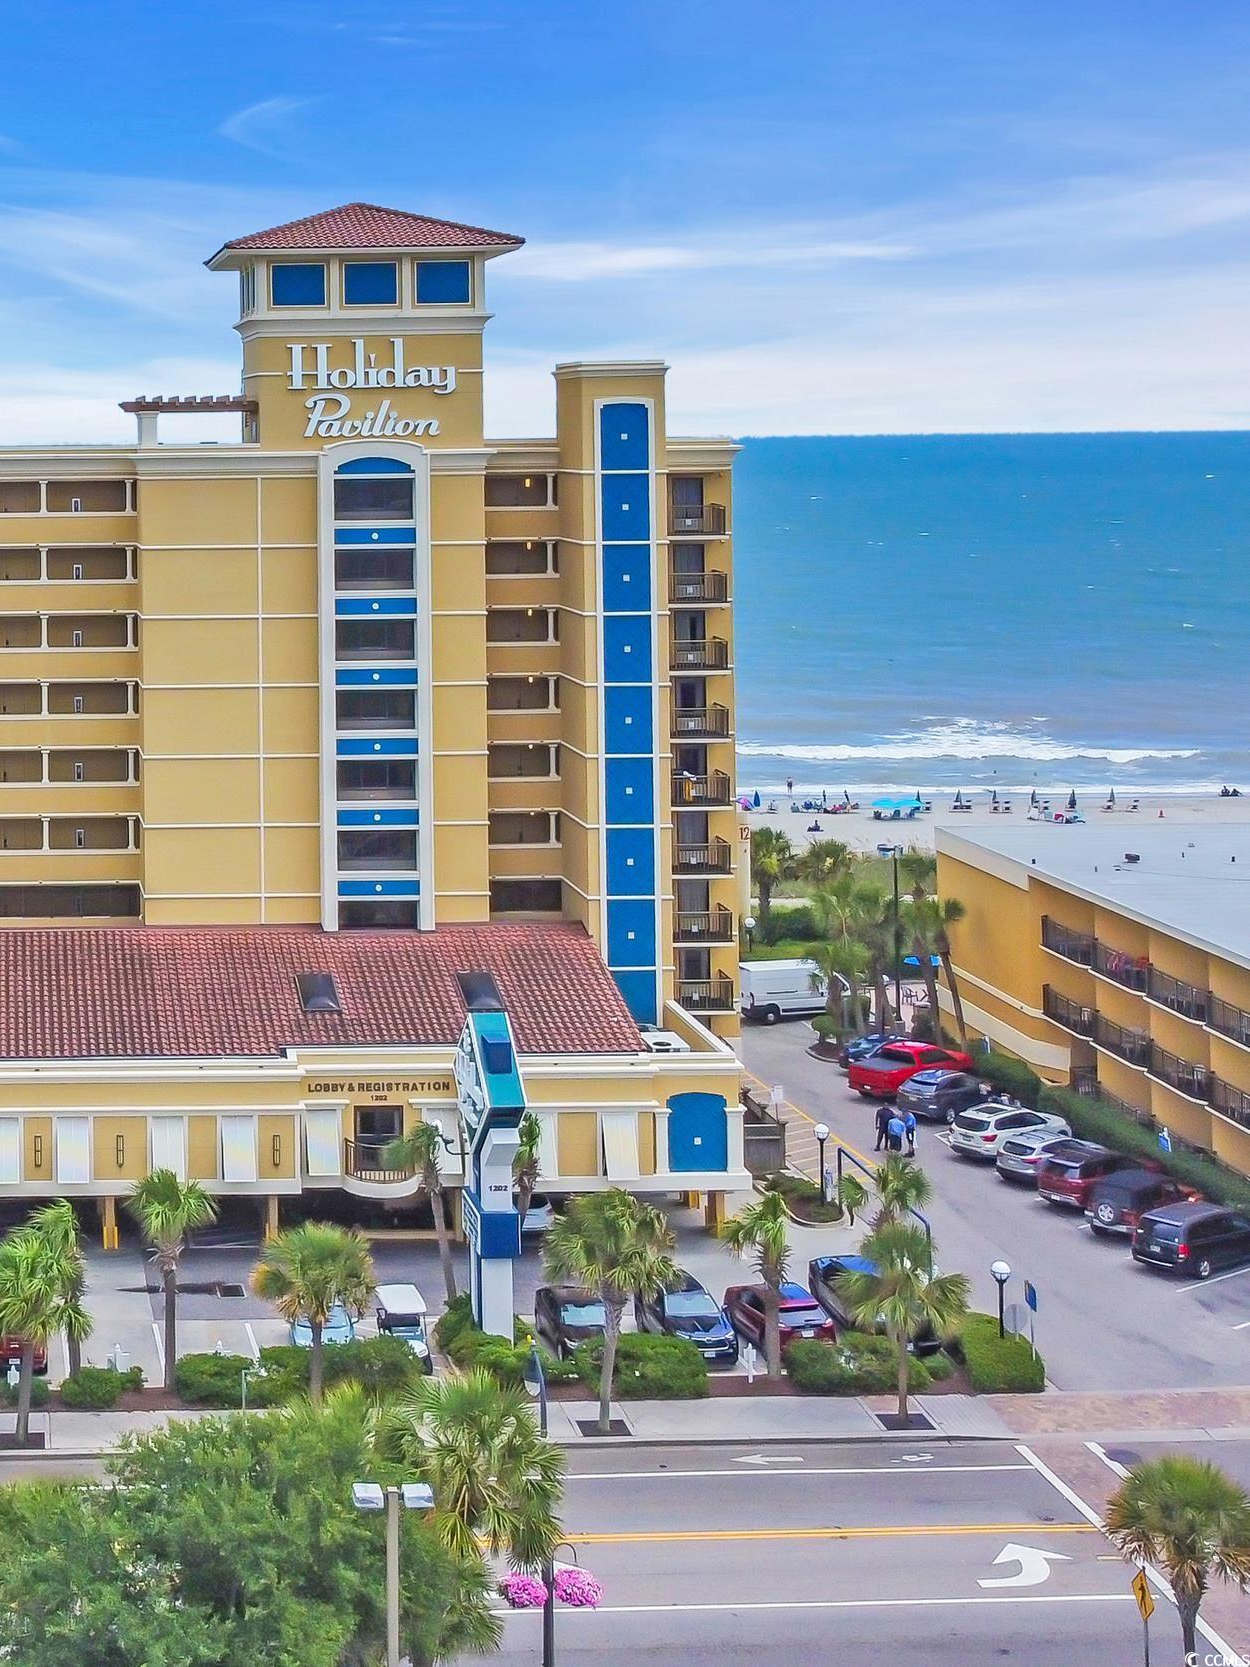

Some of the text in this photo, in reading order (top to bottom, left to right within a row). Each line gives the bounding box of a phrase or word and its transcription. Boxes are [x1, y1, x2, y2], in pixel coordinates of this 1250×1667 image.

[286, 338, 458, 395] Holiday
[303, 393, 441, 438] Pavilion
[739, 826, 750, 840] 12
[307, 1081, 450, 1093] LOBBY & REGISTRATION
[488, 1184, 509, 1192] 1202
